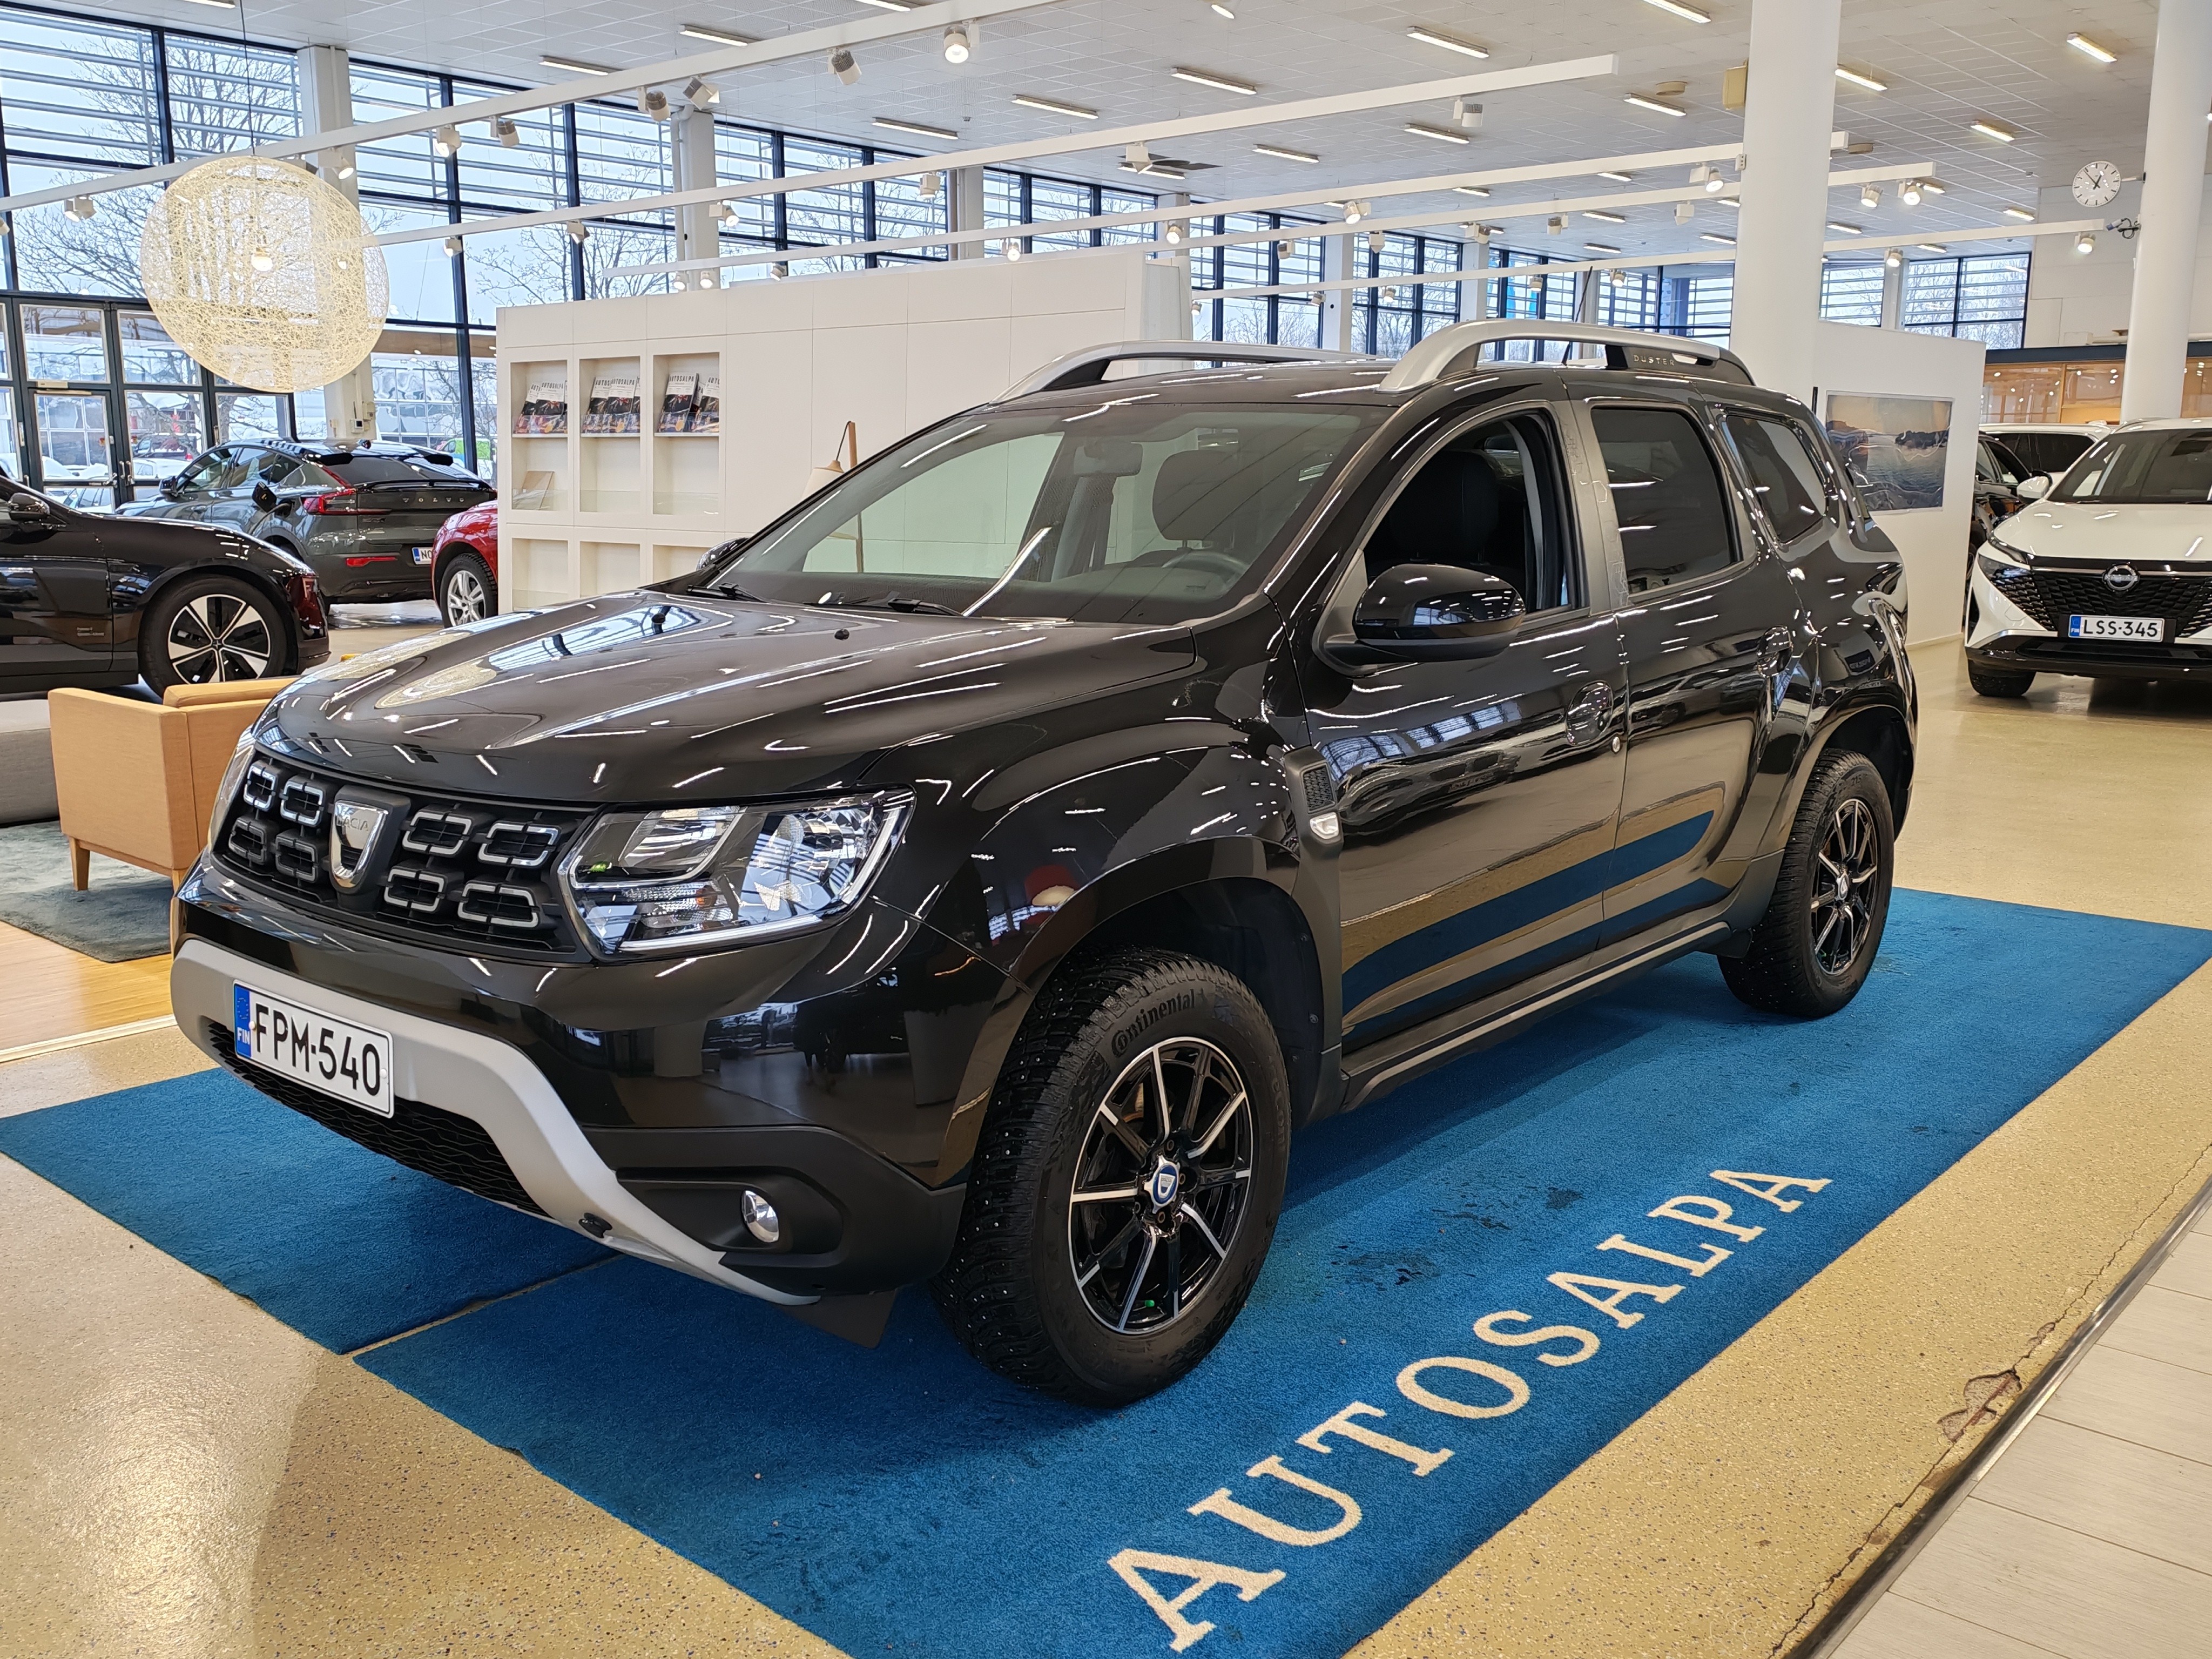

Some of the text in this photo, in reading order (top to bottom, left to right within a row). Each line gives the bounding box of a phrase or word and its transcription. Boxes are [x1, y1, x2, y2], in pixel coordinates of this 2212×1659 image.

[1634, 355, 1674, 366] DUSTER
[2083, 619, 2157, 637] LSS-345
[237, 1027, 250, 1045] FIN
[1111, 989, 1195, 1058] Continental
[255, 1003, 380, 1096] FPM-540
[1107, 1170, 1832, 1654] AUTOSALPA
